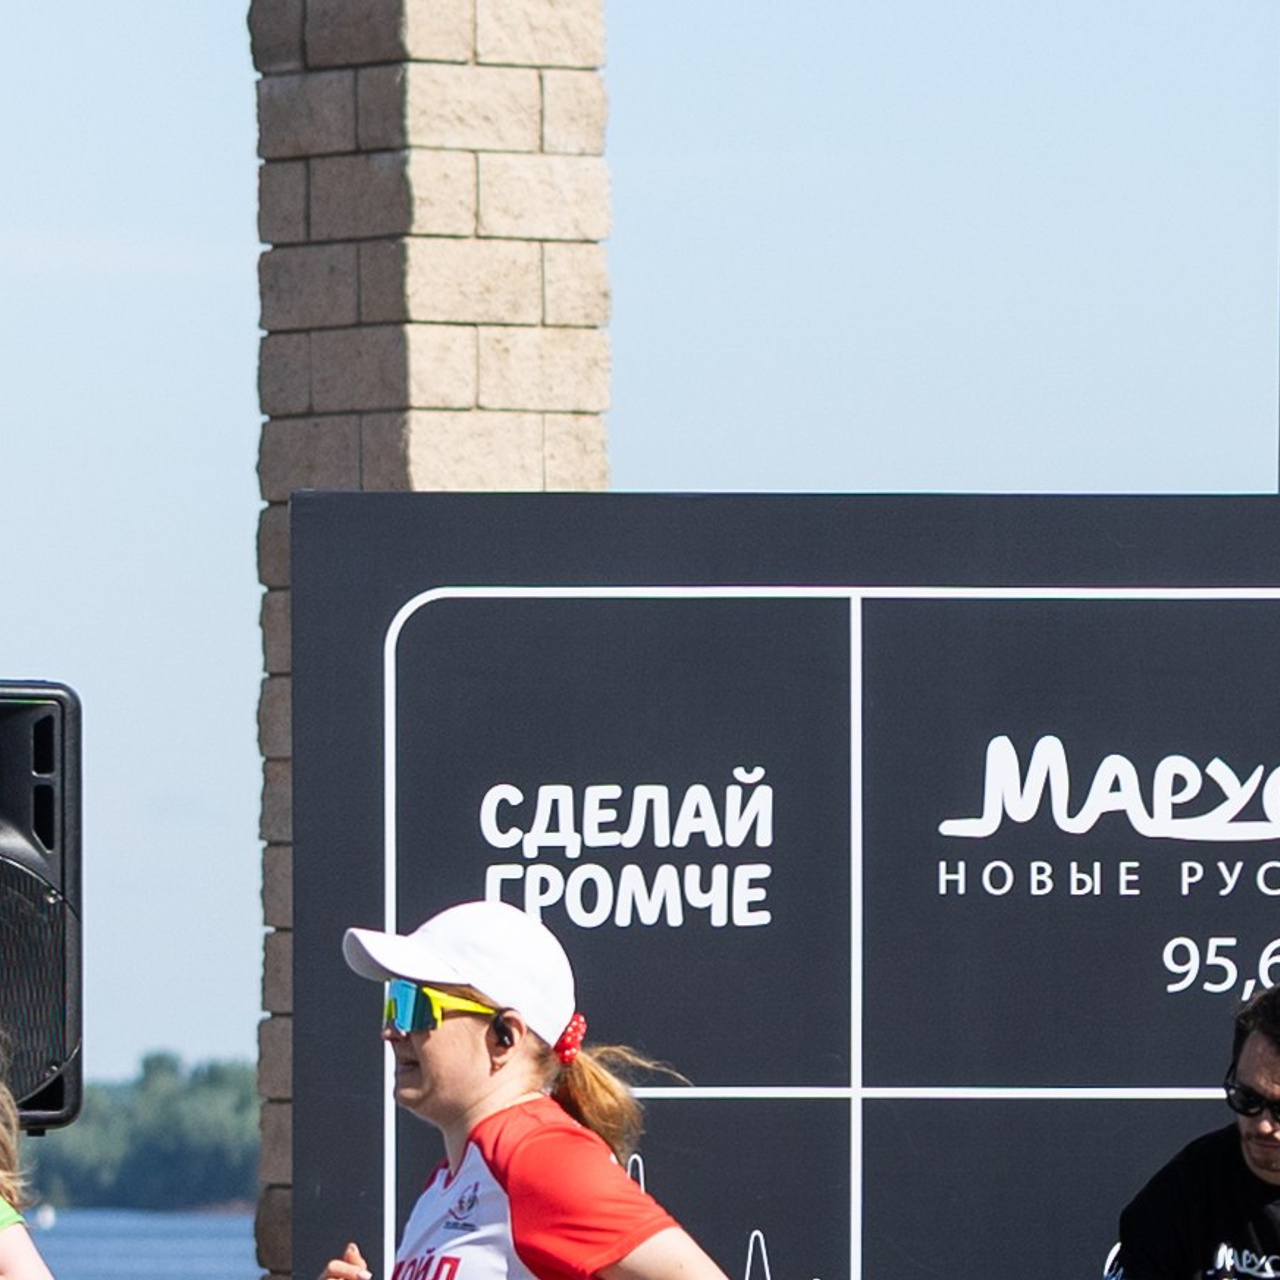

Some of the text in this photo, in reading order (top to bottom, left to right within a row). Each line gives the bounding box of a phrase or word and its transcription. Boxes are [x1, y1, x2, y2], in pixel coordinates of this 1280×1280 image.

[480, 766, 774, 859] СДЕЛАЙ
[485, 863, 772, 929] ГРОМЧЕ
[938, 860, 1141, 896] НОВЫЕ
